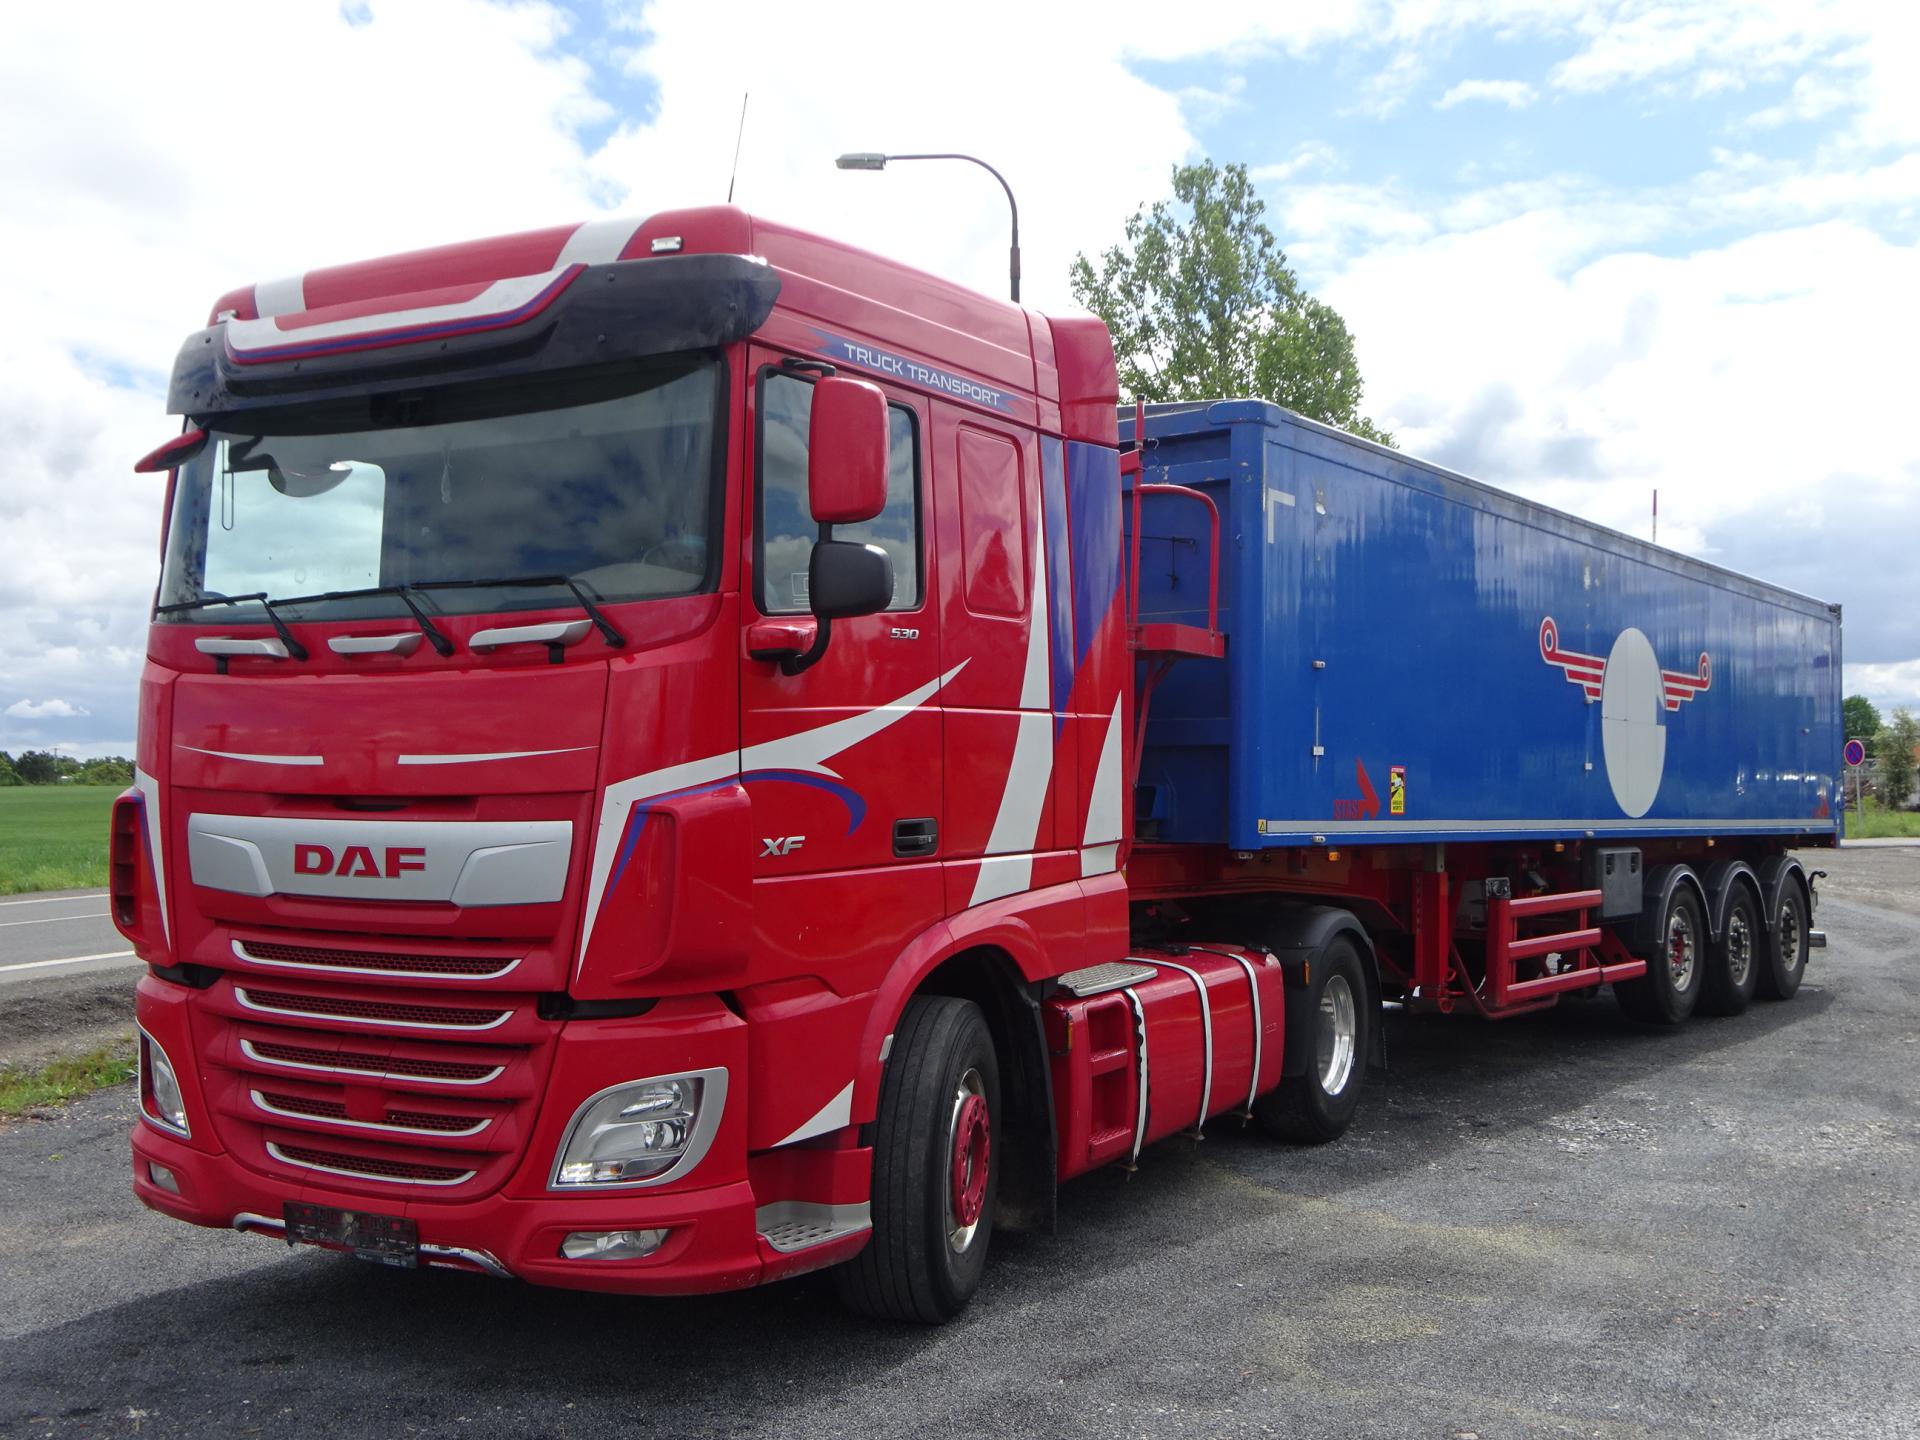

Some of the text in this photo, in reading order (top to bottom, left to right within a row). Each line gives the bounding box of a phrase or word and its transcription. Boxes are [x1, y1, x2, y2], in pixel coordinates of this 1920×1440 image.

[843, 343, 1000, 406] TRUCK TRANSPORT
[890, 628, 920, 640] 530
[759, 835, 806, 857] XF
[294, 843, 426, 878] DAF
